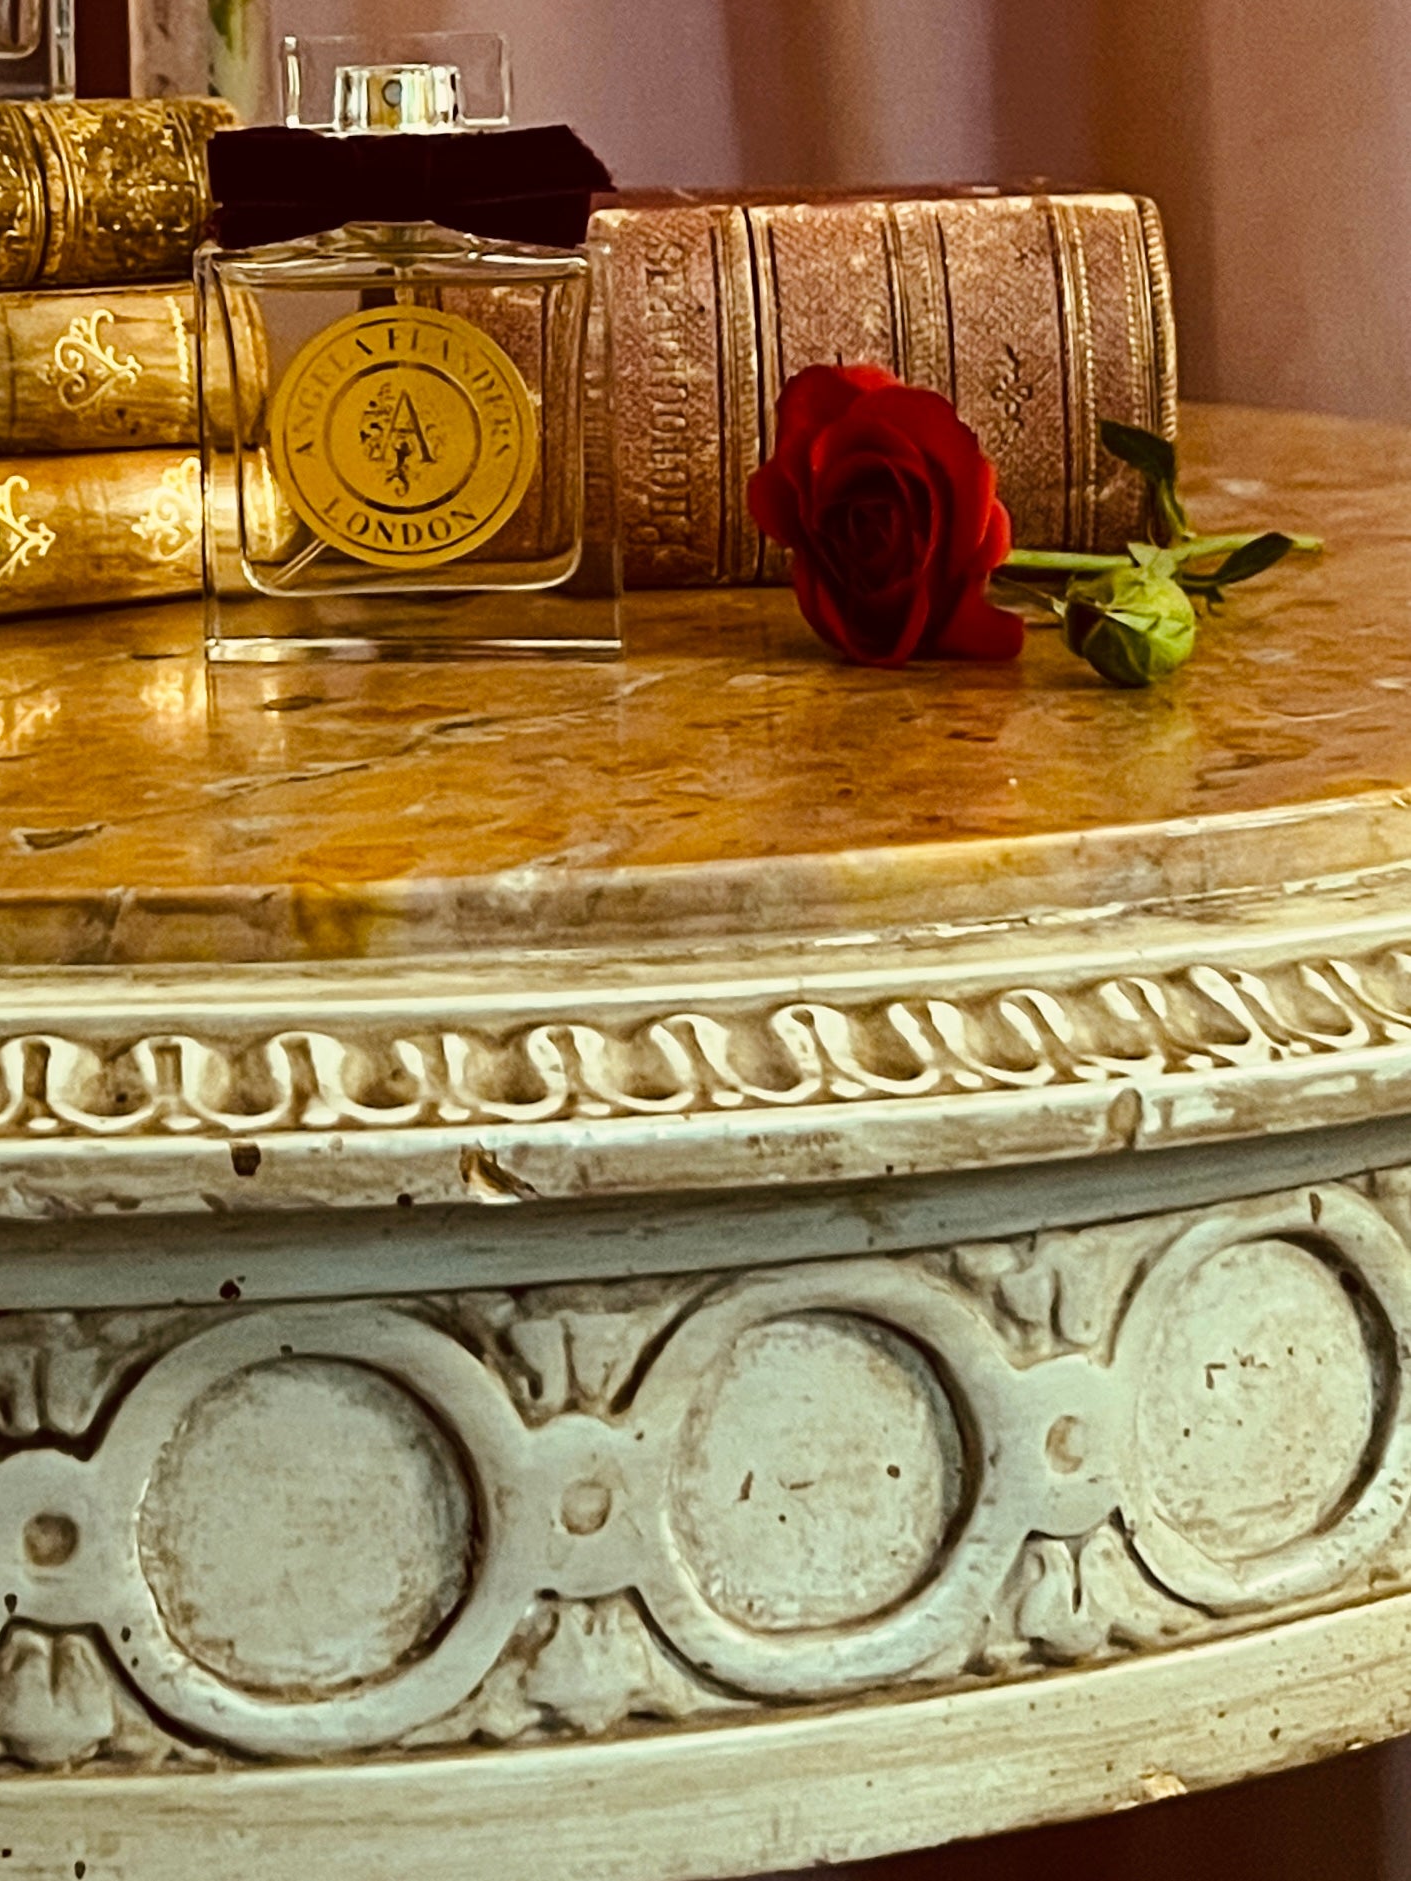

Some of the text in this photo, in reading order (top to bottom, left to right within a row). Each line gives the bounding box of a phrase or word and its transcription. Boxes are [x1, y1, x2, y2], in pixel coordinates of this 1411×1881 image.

[294, 327, 513, 460] ANGELA FLANDERS
[375, 389, 437, 463] A
[323, 496, 478, 546] LONDON
